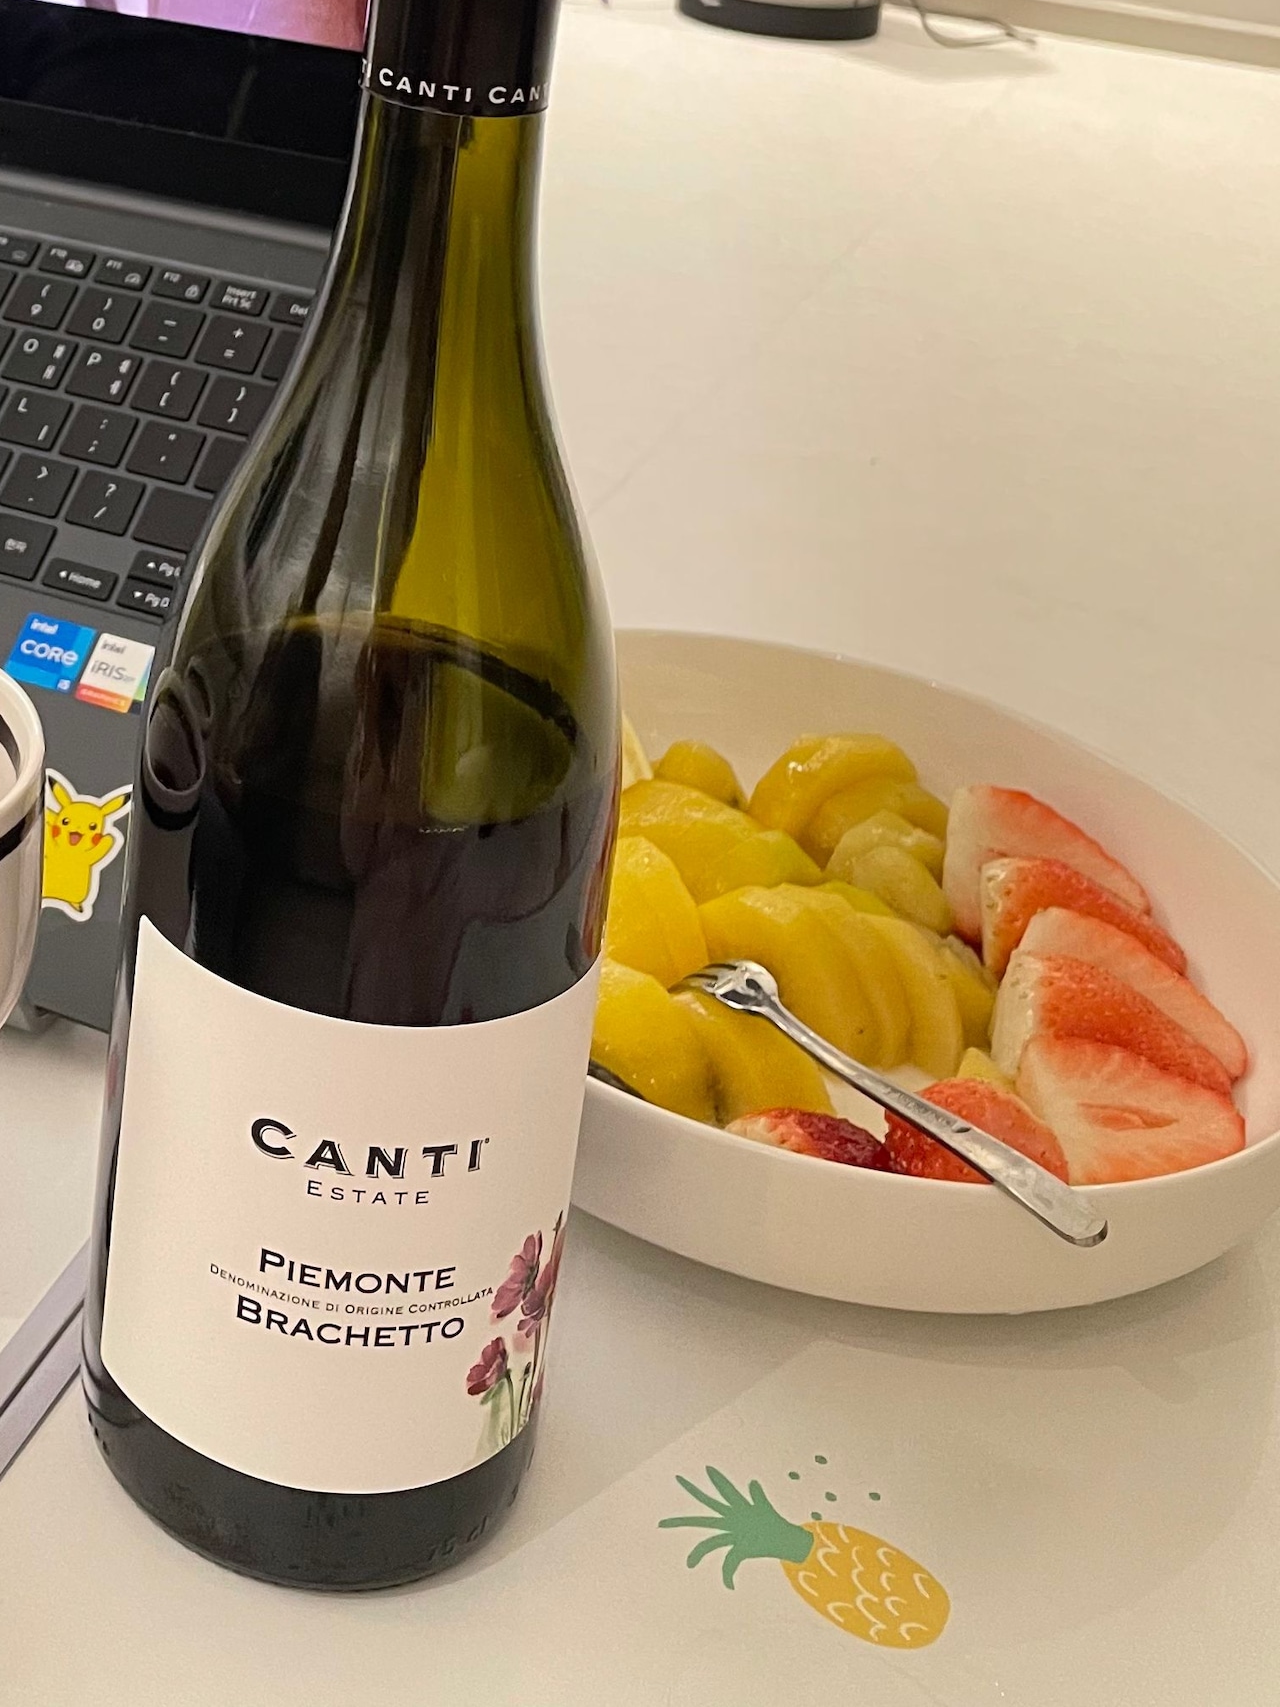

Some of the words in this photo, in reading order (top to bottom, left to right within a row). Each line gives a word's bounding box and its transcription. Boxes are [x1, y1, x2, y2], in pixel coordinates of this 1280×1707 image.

[378, 67, 472, 103] CANTI
[106, 259, 123, 270] F11
[86, 352, 102, 366] P
[17, 397, 28, 413] L
[30, 618, 59, 635] intel
[251, 1118, 484, 1179] CANTI
[307, 1179, 430, 1205] ESTATE
[259, 1247, 456, 1294] PIEMONTE
[210, 1263, 320, 1310] DENOMINAZIONE
[325, 1303, 340, 1312] DI
[345, 1304, 403, 1315] ORIGINE
[408, 1286, 494, 1314] CONTROLLATA
[236, 1294, 465, 1347] BRACHETTO
